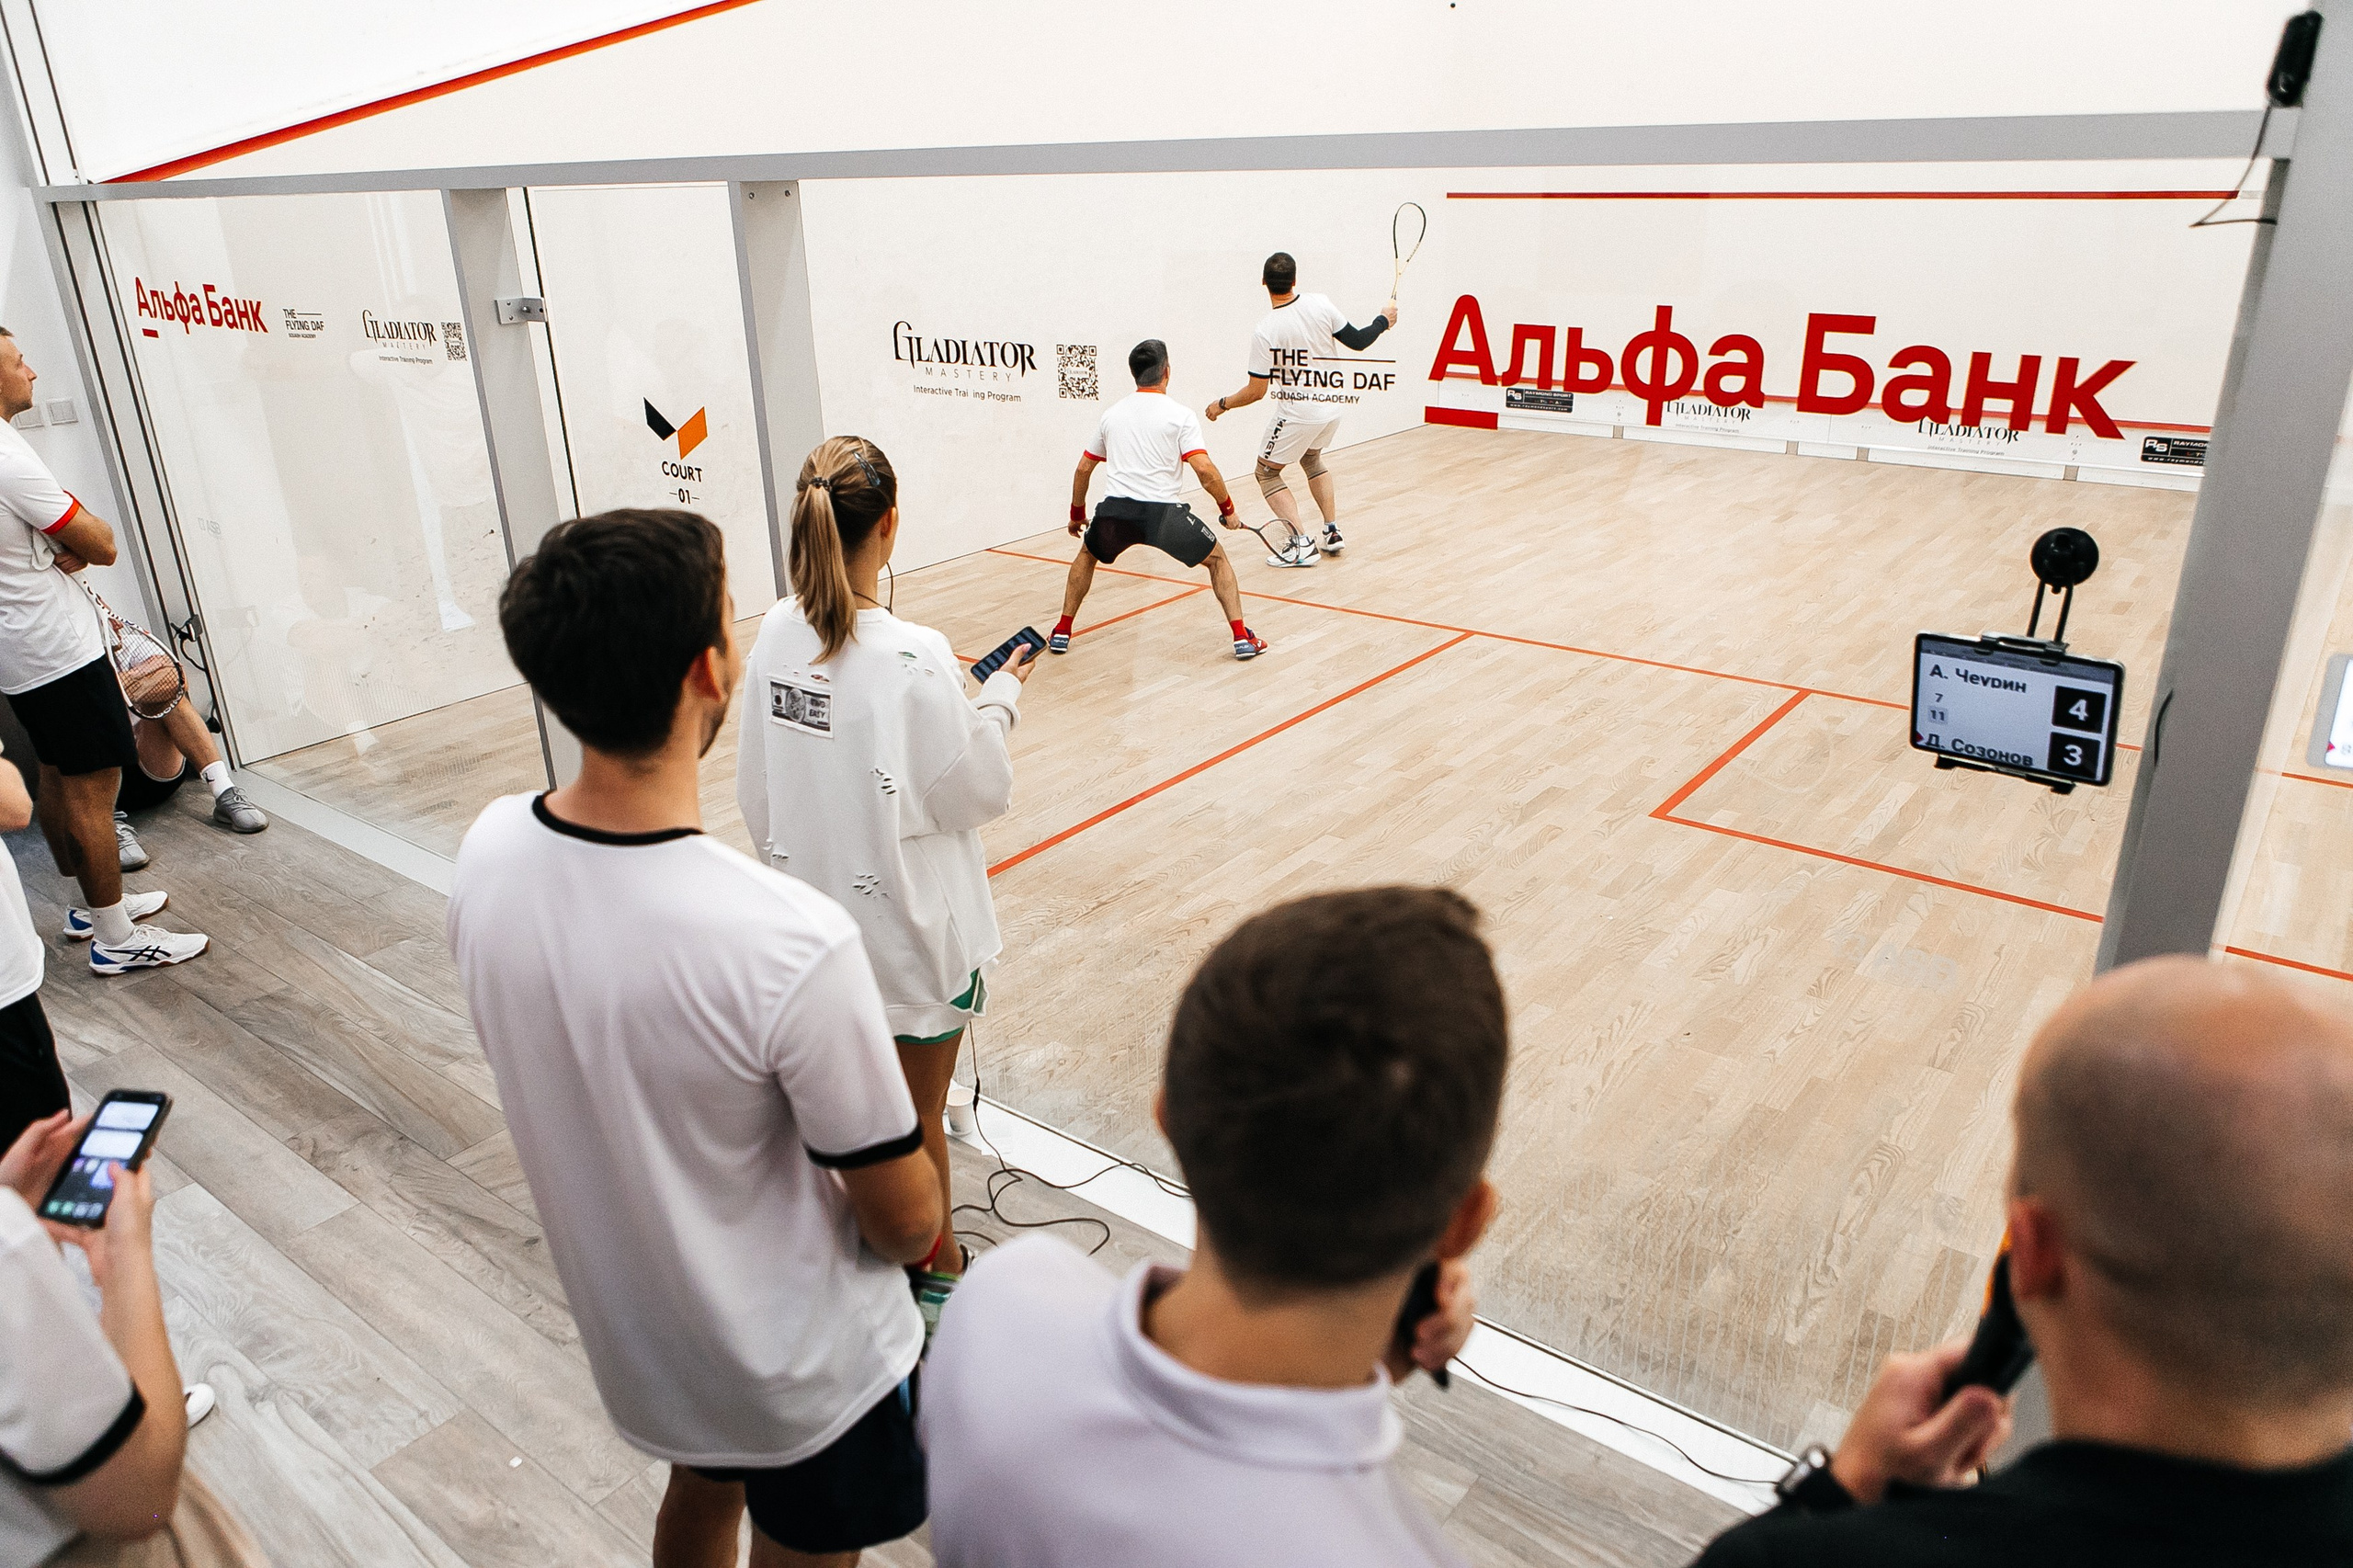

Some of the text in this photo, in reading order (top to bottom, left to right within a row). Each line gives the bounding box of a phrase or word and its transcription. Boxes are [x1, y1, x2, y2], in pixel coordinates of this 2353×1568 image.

[135, 277, 268, 335] Альфа Банк
[282, 308, 297, 319] THE
[285, 320, 324, 331] FLYING DAF
[892, 321, 1038, 378] GLADIATOR
[1269, 348, 1308, 366] THE
[925, 367, 1012, 381] MASTERY
[1428, 294, 2138, 439] Альфа Банк
[1269, 369, 1395, 391] FLYING DAF
[914, 385, 1021, 403] Interactive Traiing Program
[1270, 391, 1360, 404] SQUASH ACADEMY
[662, 460, 702, 483] COURT
[678, 488, 690, 504] 01
[1935, 693, 1943, 703] 7
[1930, 710, 1945, 722] 11
[2069, 699, 2088, 722] 4
[1950, 738, 2034, 767] Созонов
[2063, 744, 2083, 767] 3
